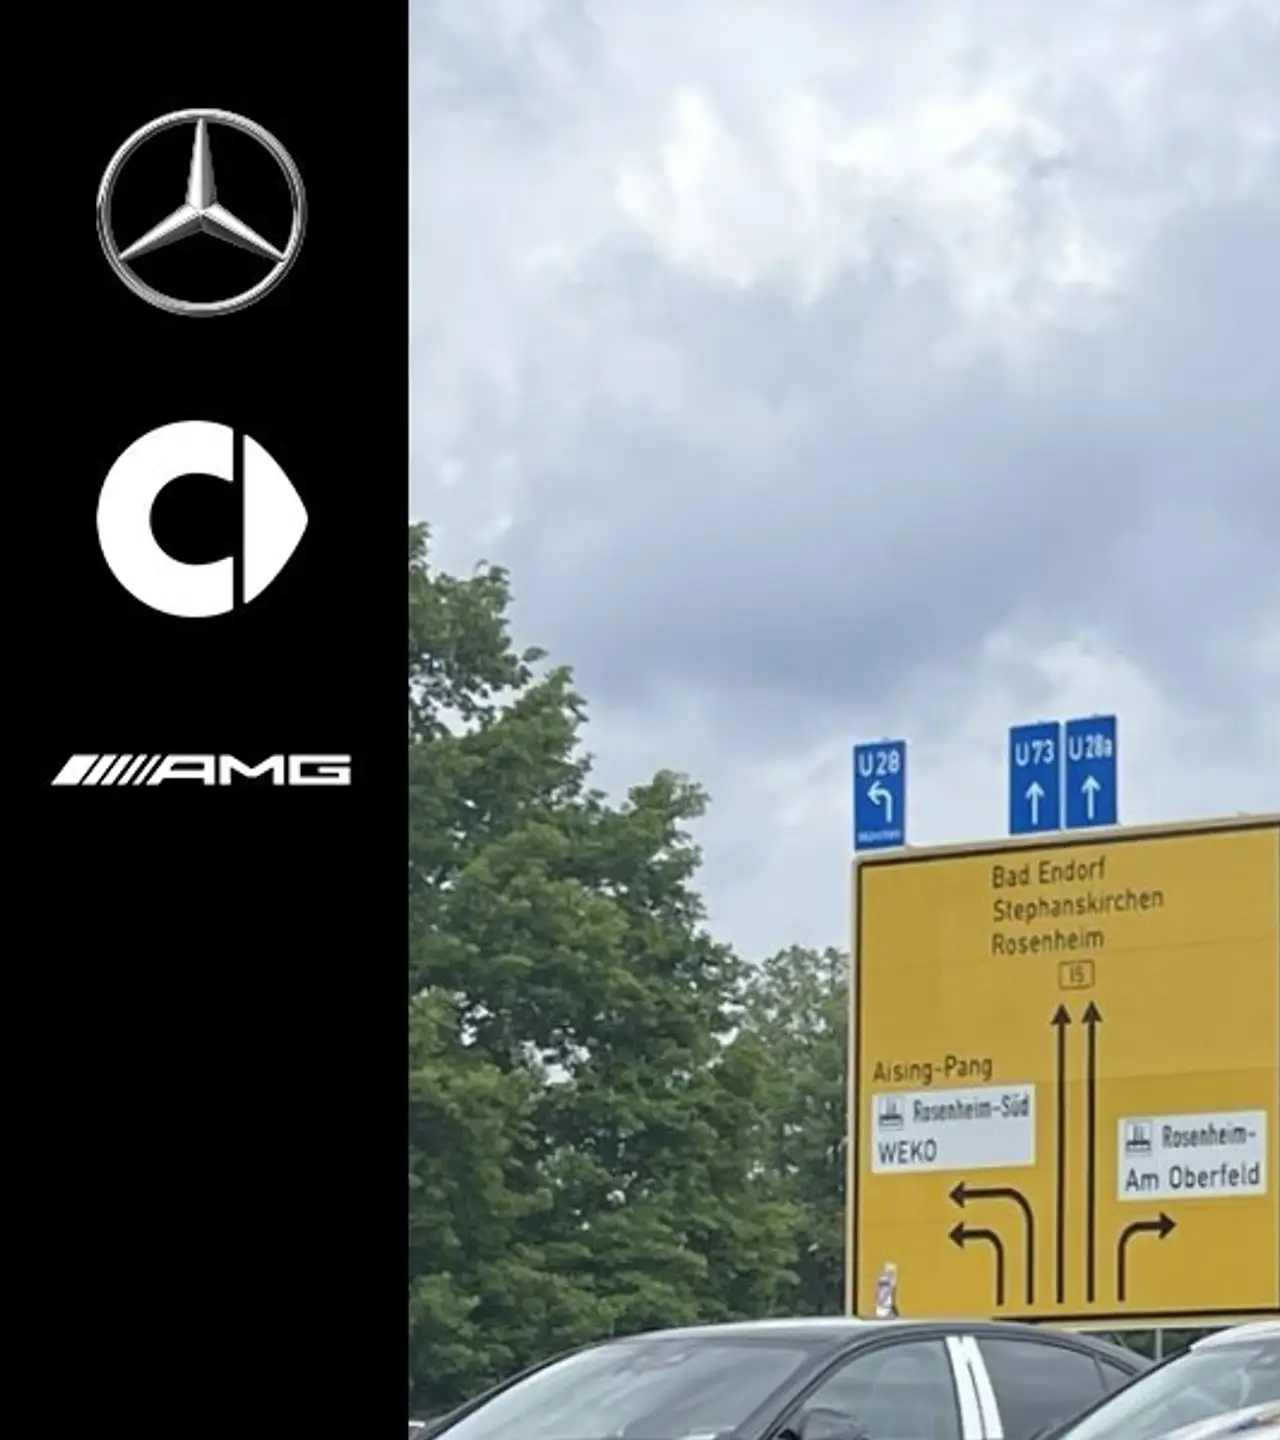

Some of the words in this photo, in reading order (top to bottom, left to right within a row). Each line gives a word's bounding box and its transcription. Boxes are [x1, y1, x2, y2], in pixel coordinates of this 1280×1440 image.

[992, 863, 1030, 889] Bad
[1039, 855, 1106, 884] Endorf
[993, 889, 1164, 925] Stephanskirchen
[992, 929, 1105, 956] Rosenheim
[1069, 964, 1085, 983] 15
[873, 1054, 993, 1086] Aising-Pang
[913, 1091, 1030, 1122] Rosenheim-Süd
[1162, 1121, 1256, 1149] Rosenheim-
[878, 1138, 938, 1164] WEKO
[1125, 1167, 1160, 1191] Am
[1168, 1160, 1260, 1189] Oberfeld
